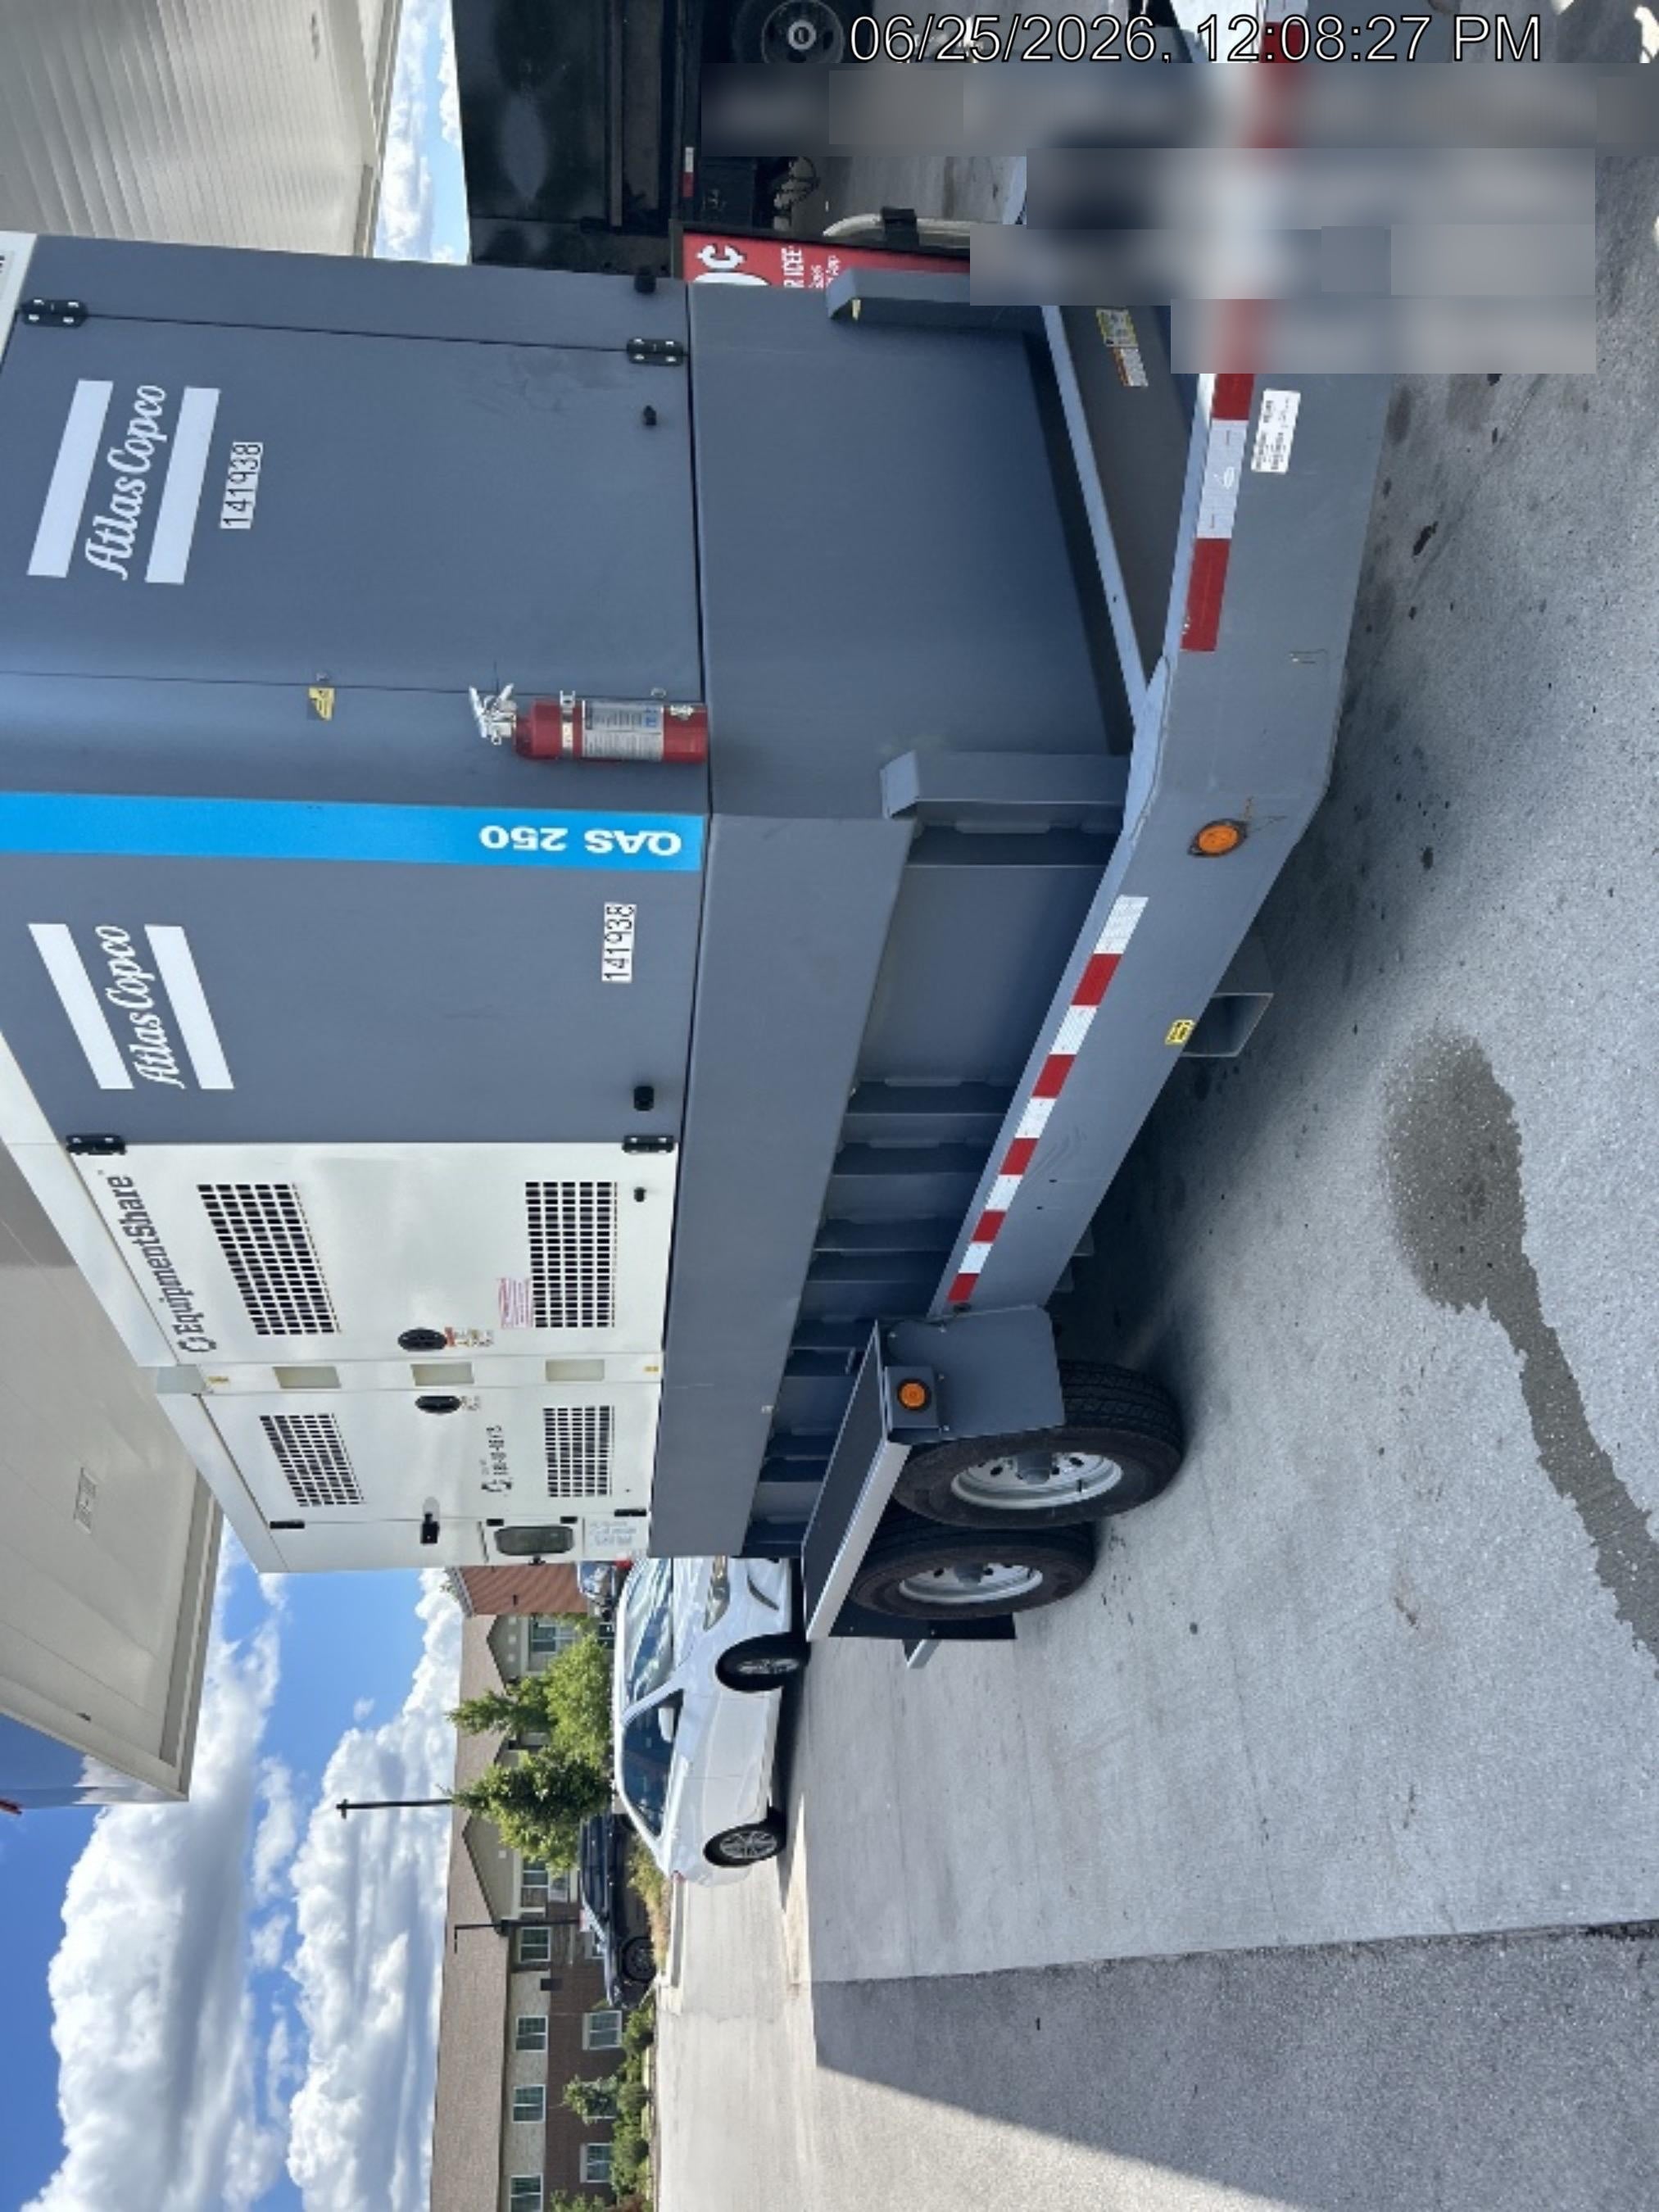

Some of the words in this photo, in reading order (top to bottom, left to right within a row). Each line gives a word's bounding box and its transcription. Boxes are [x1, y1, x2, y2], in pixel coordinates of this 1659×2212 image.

[107, 385, 167, 474] Copco
[223, 443, 263, 527] 141938
[85, 476, 147, 580] Atlas
[479, 825, 569, 852] 250
[584, 829, 682, 856] QAS
[94, 925, 156, 1009] Copco
[604, 905, 635, 980] 141938
[129, 1012, 187, 1090] Atlas
[107, 1176, 205, 1335] EquipmentShare
